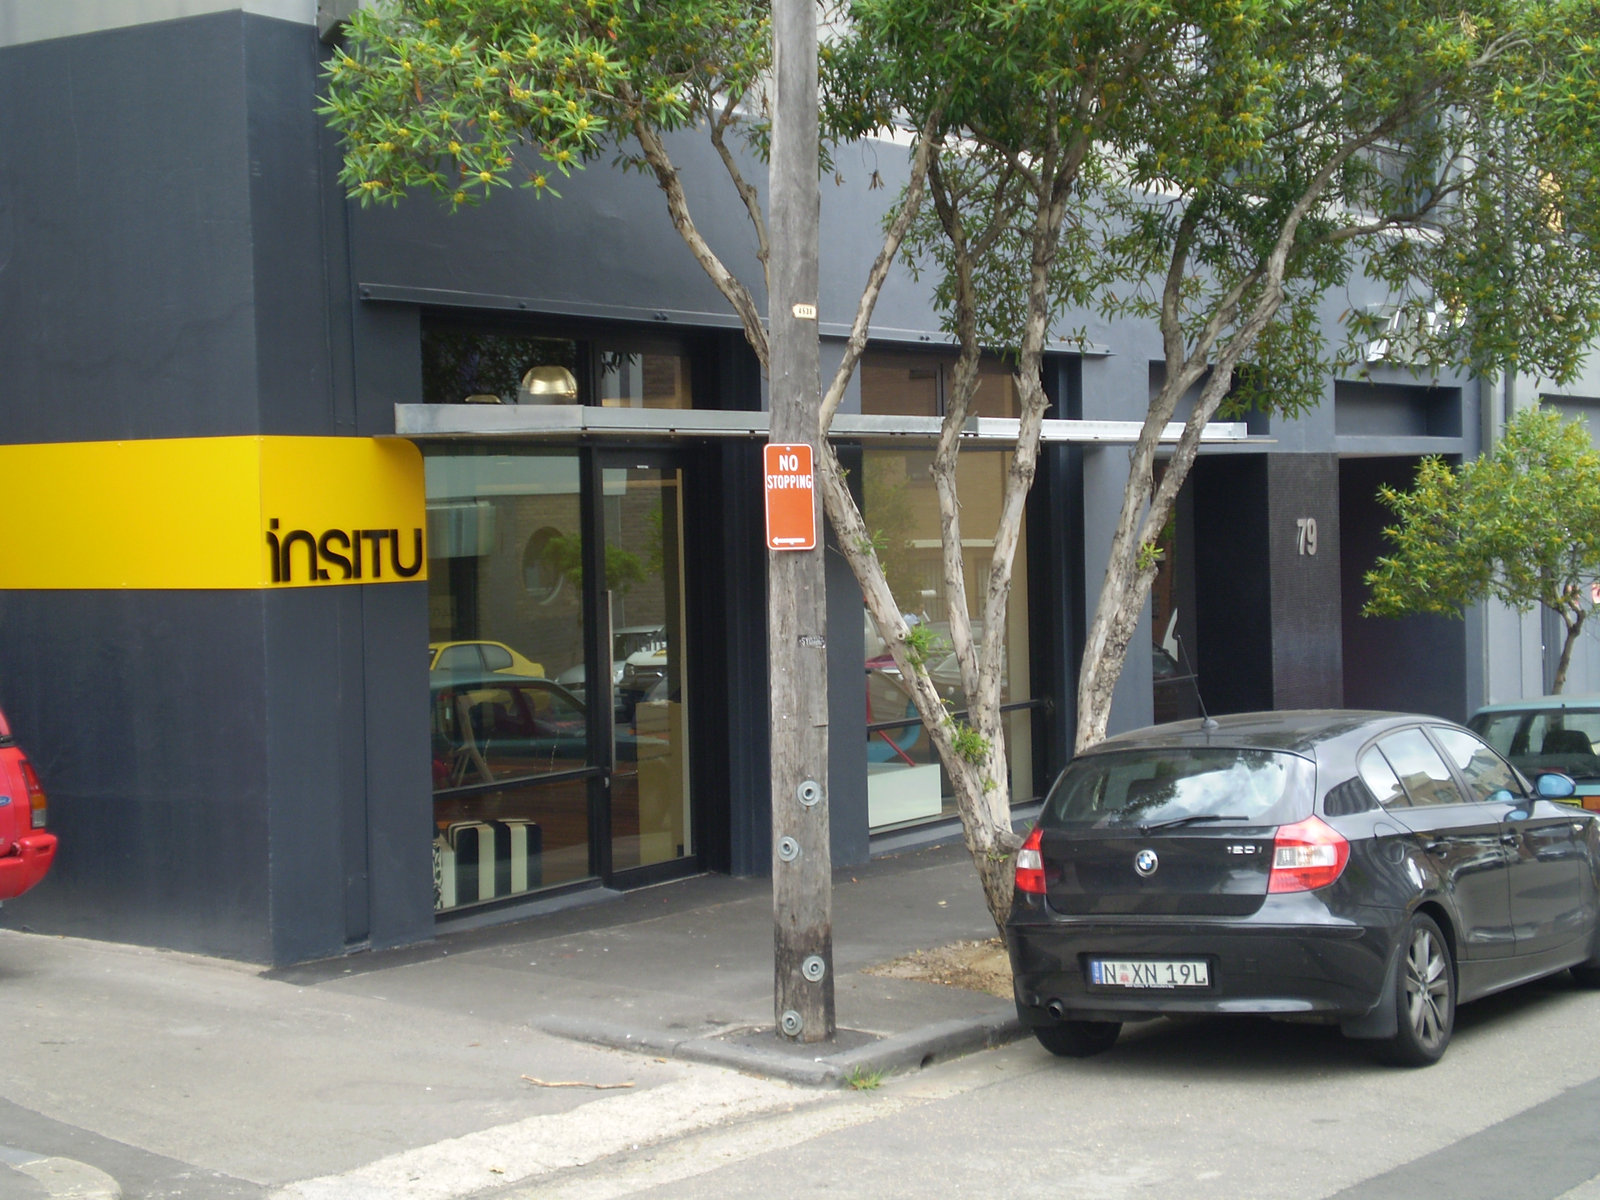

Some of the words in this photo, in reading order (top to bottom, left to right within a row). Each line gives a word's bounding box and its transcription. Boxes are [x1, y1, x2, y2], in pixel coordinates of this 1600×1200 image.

[779, 455, 798, 471] NO
[767, 475, 812, 489] STOPPING
[1296, 518, 1317, 556] 79
[1166, 964, 1206, 984] 19L
